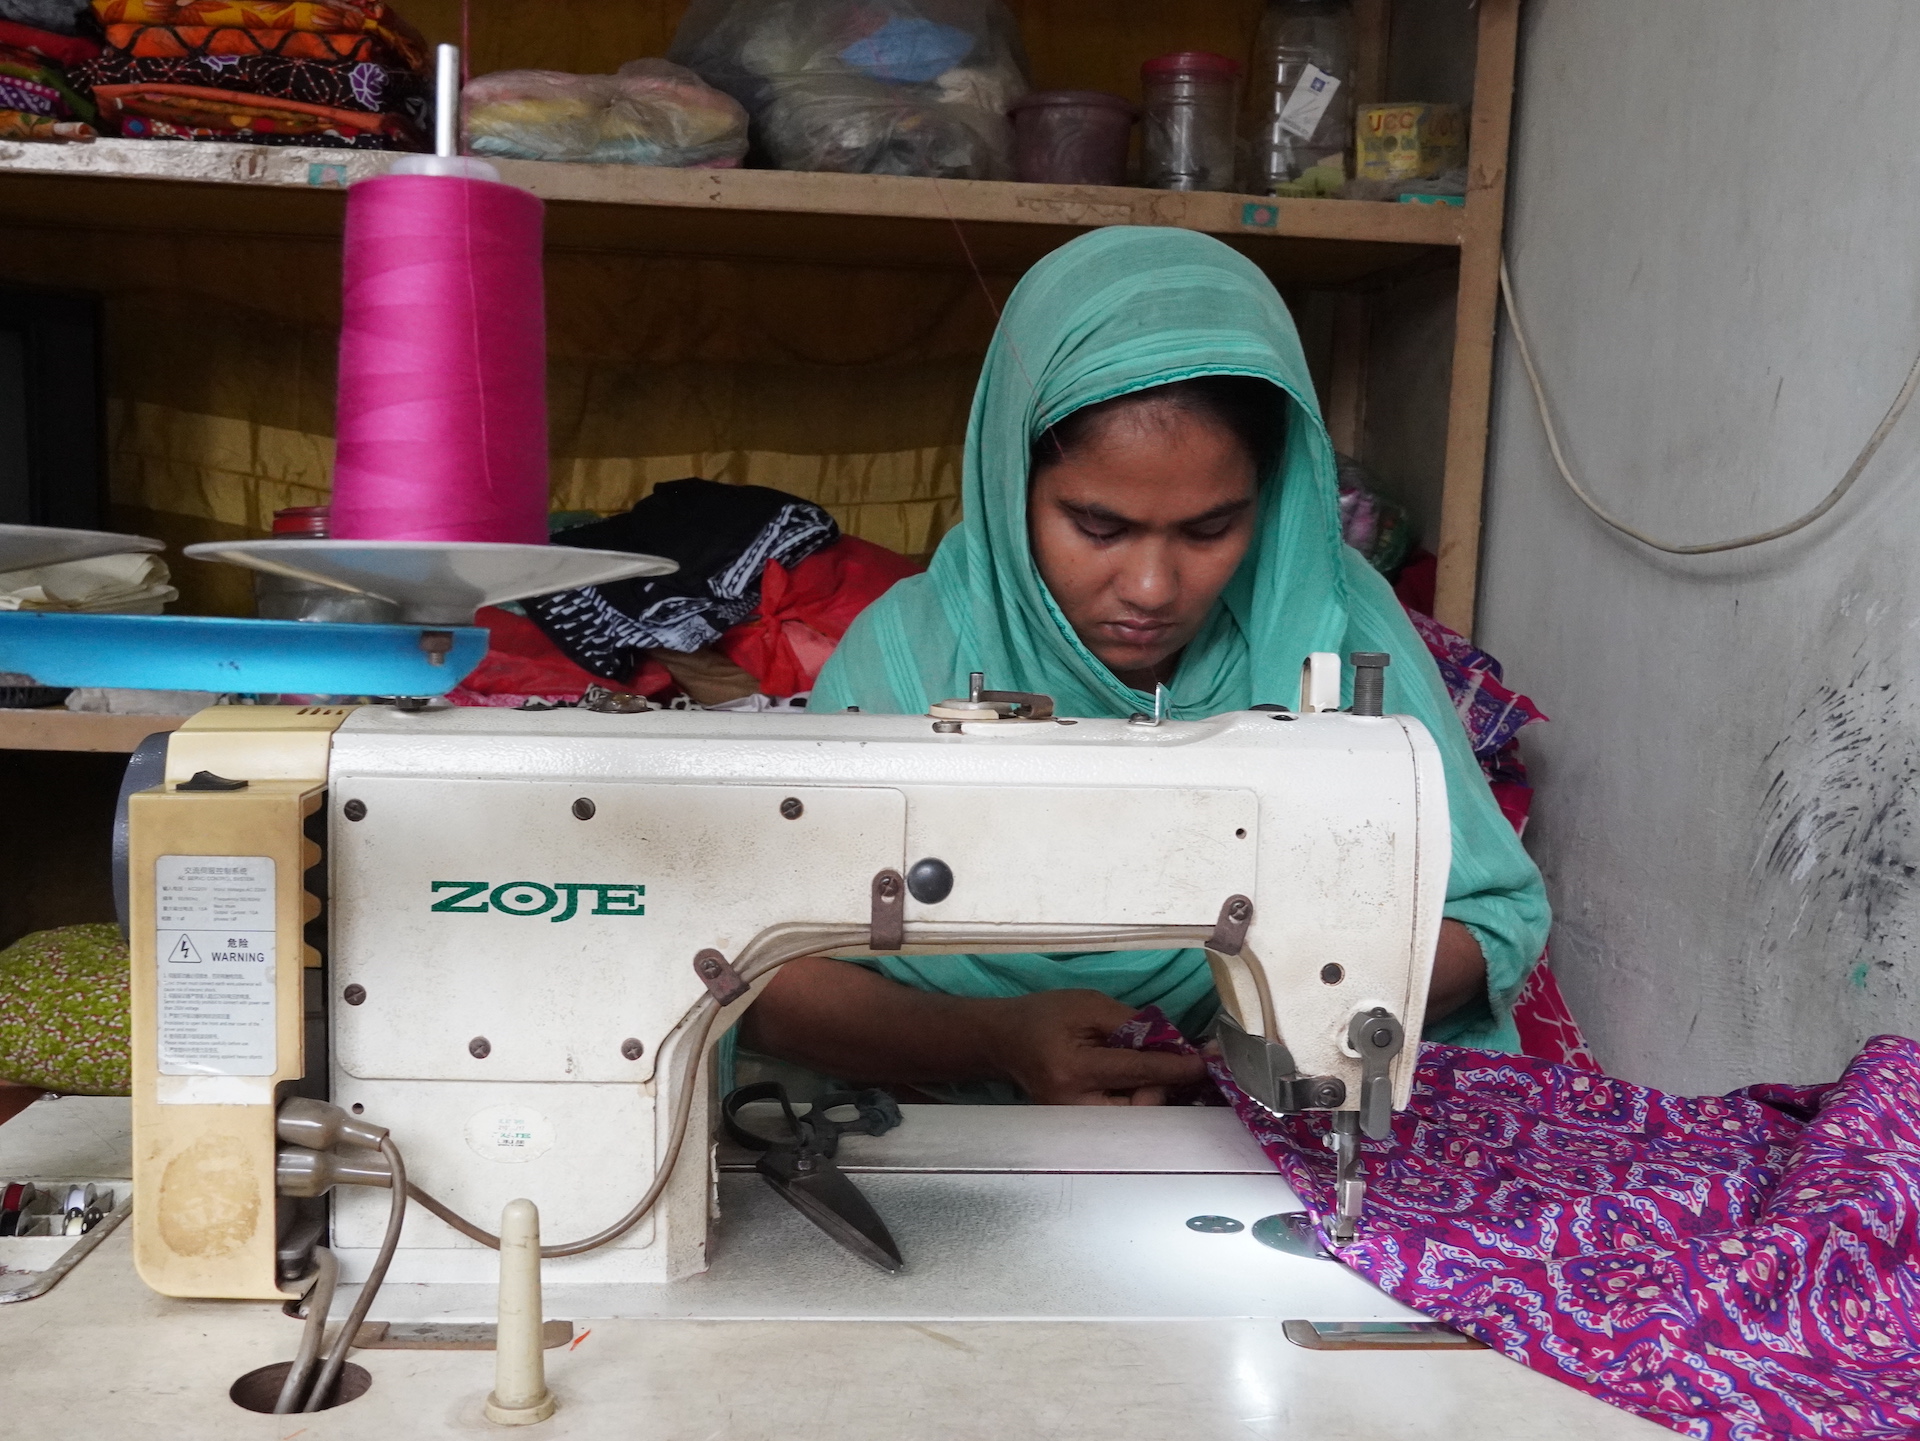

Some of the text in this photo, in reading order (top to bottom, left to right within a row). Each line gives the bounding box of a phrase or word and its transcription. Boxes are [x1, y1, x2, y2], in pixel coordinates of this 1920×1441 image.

[431, 880, 645, 923] ZOJE
[227, 938, 249, 948] 危险
[211, 952, 265, 963] WARNING
